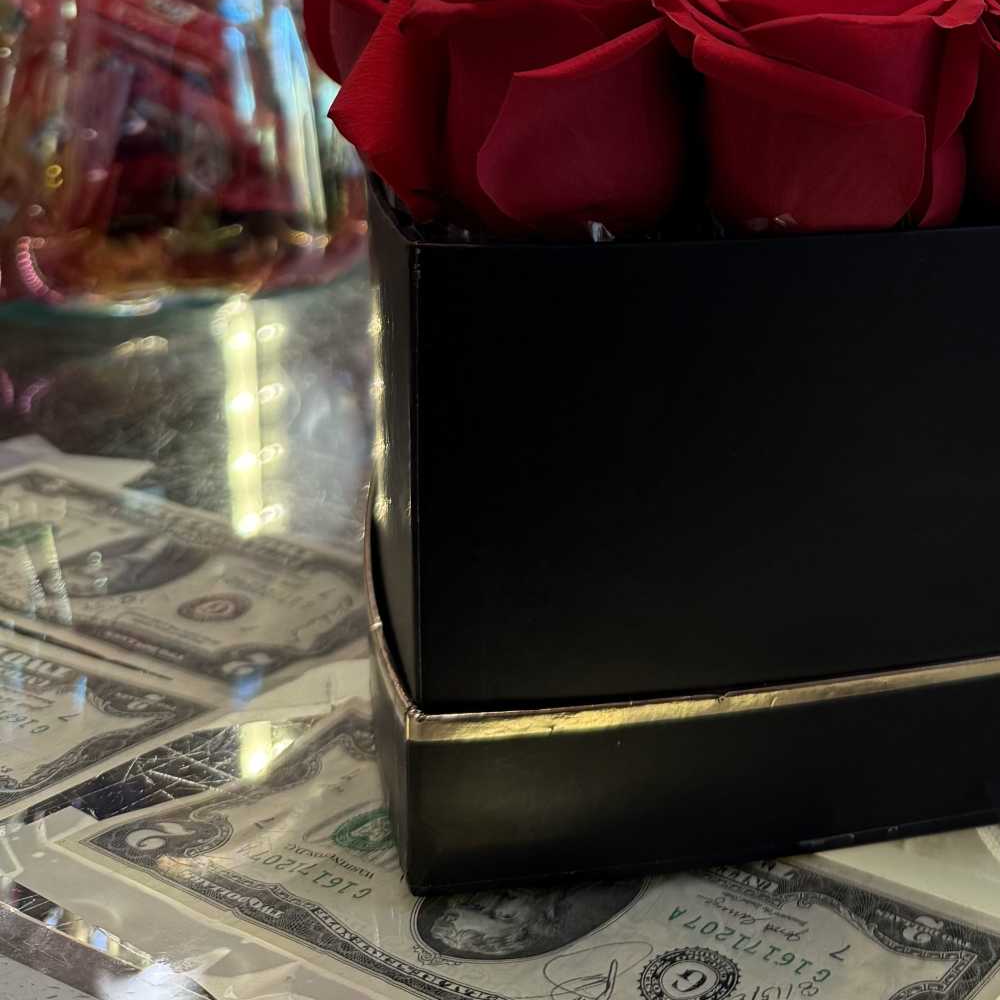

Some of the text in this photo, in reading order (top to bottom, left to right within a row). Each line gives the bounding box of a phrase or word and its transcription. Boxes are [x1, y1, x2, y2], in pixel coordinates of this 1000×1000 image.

[668, 906, 832, 983] G16171207A
[829, 944, 851, 962] 7
[671, 968, 708, 993] G
